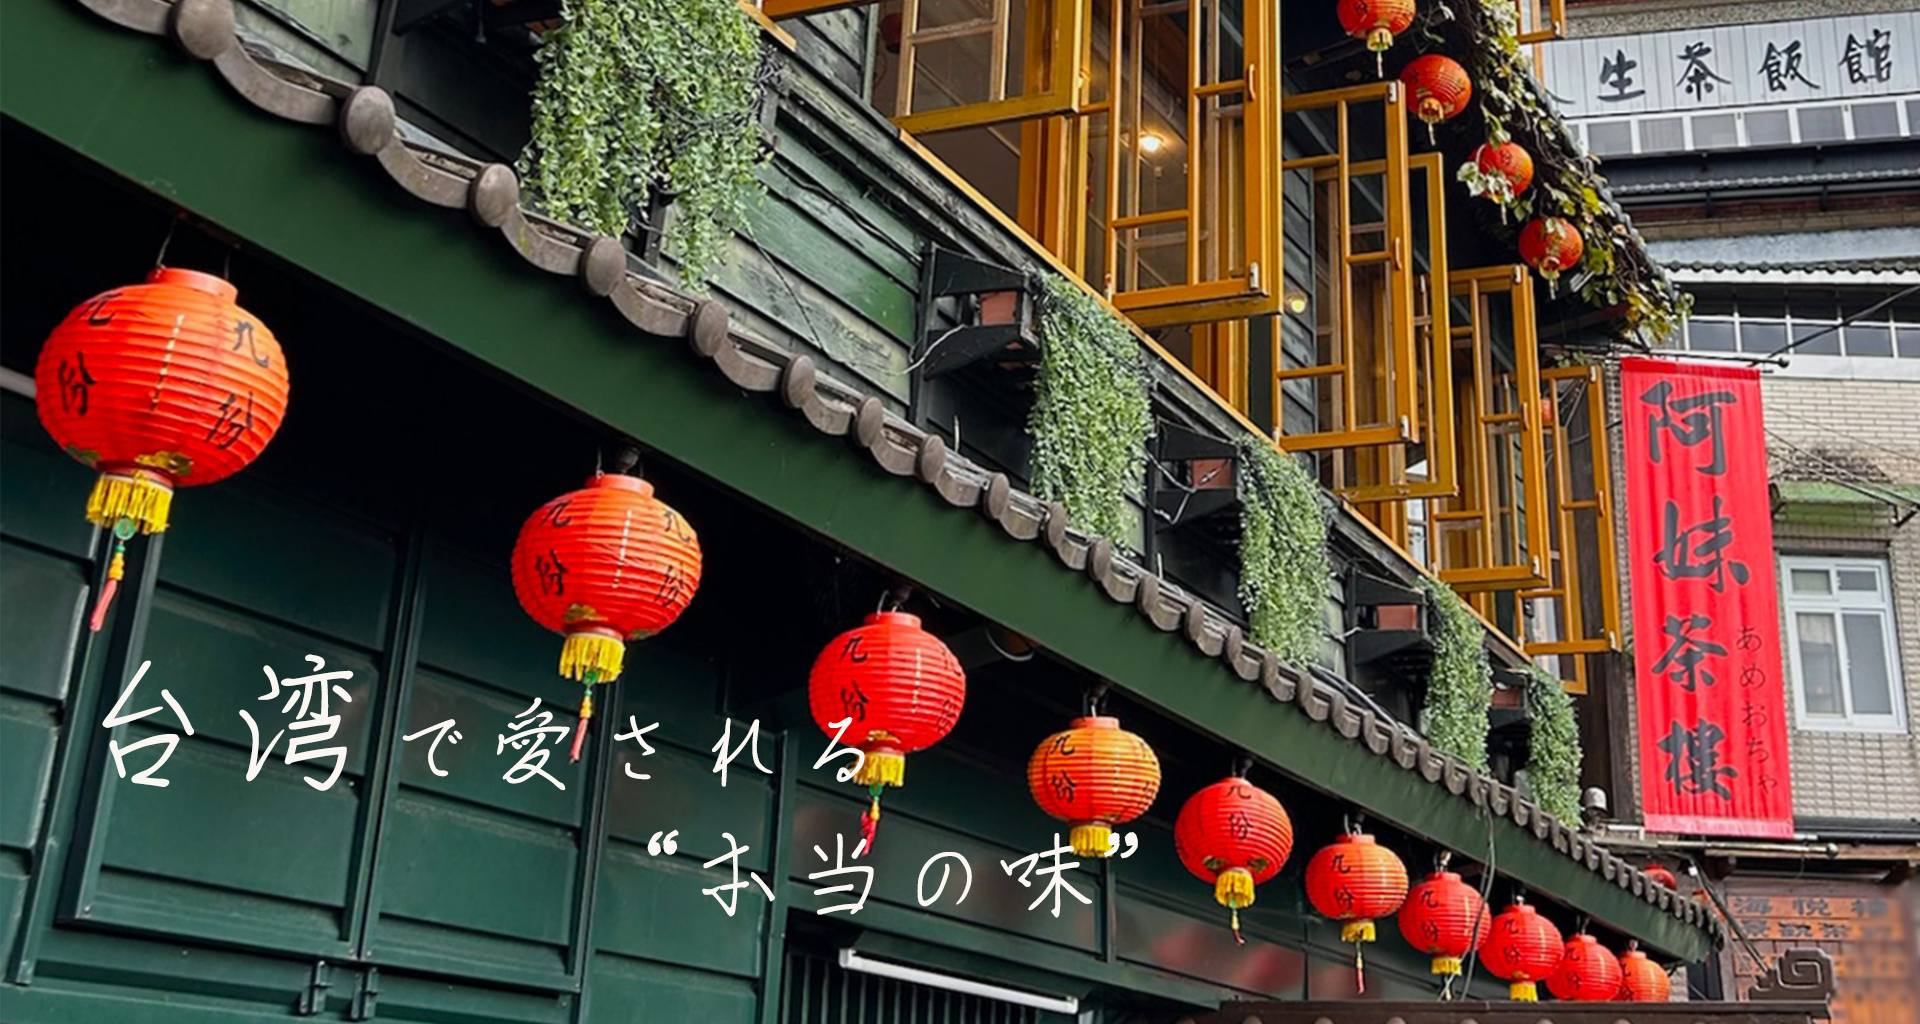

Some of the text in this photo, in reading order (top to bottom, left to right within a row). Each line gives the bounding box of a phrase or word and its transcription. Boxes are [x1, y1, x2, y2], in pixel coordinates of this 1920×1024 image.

[1545, 28, 1893, 104] 生茶飯館
[58, 292, 122, 415] 九份
[205, 319, 269, 449] 九份
[1640, 380, 1750, 801] 阿妹茶樓
